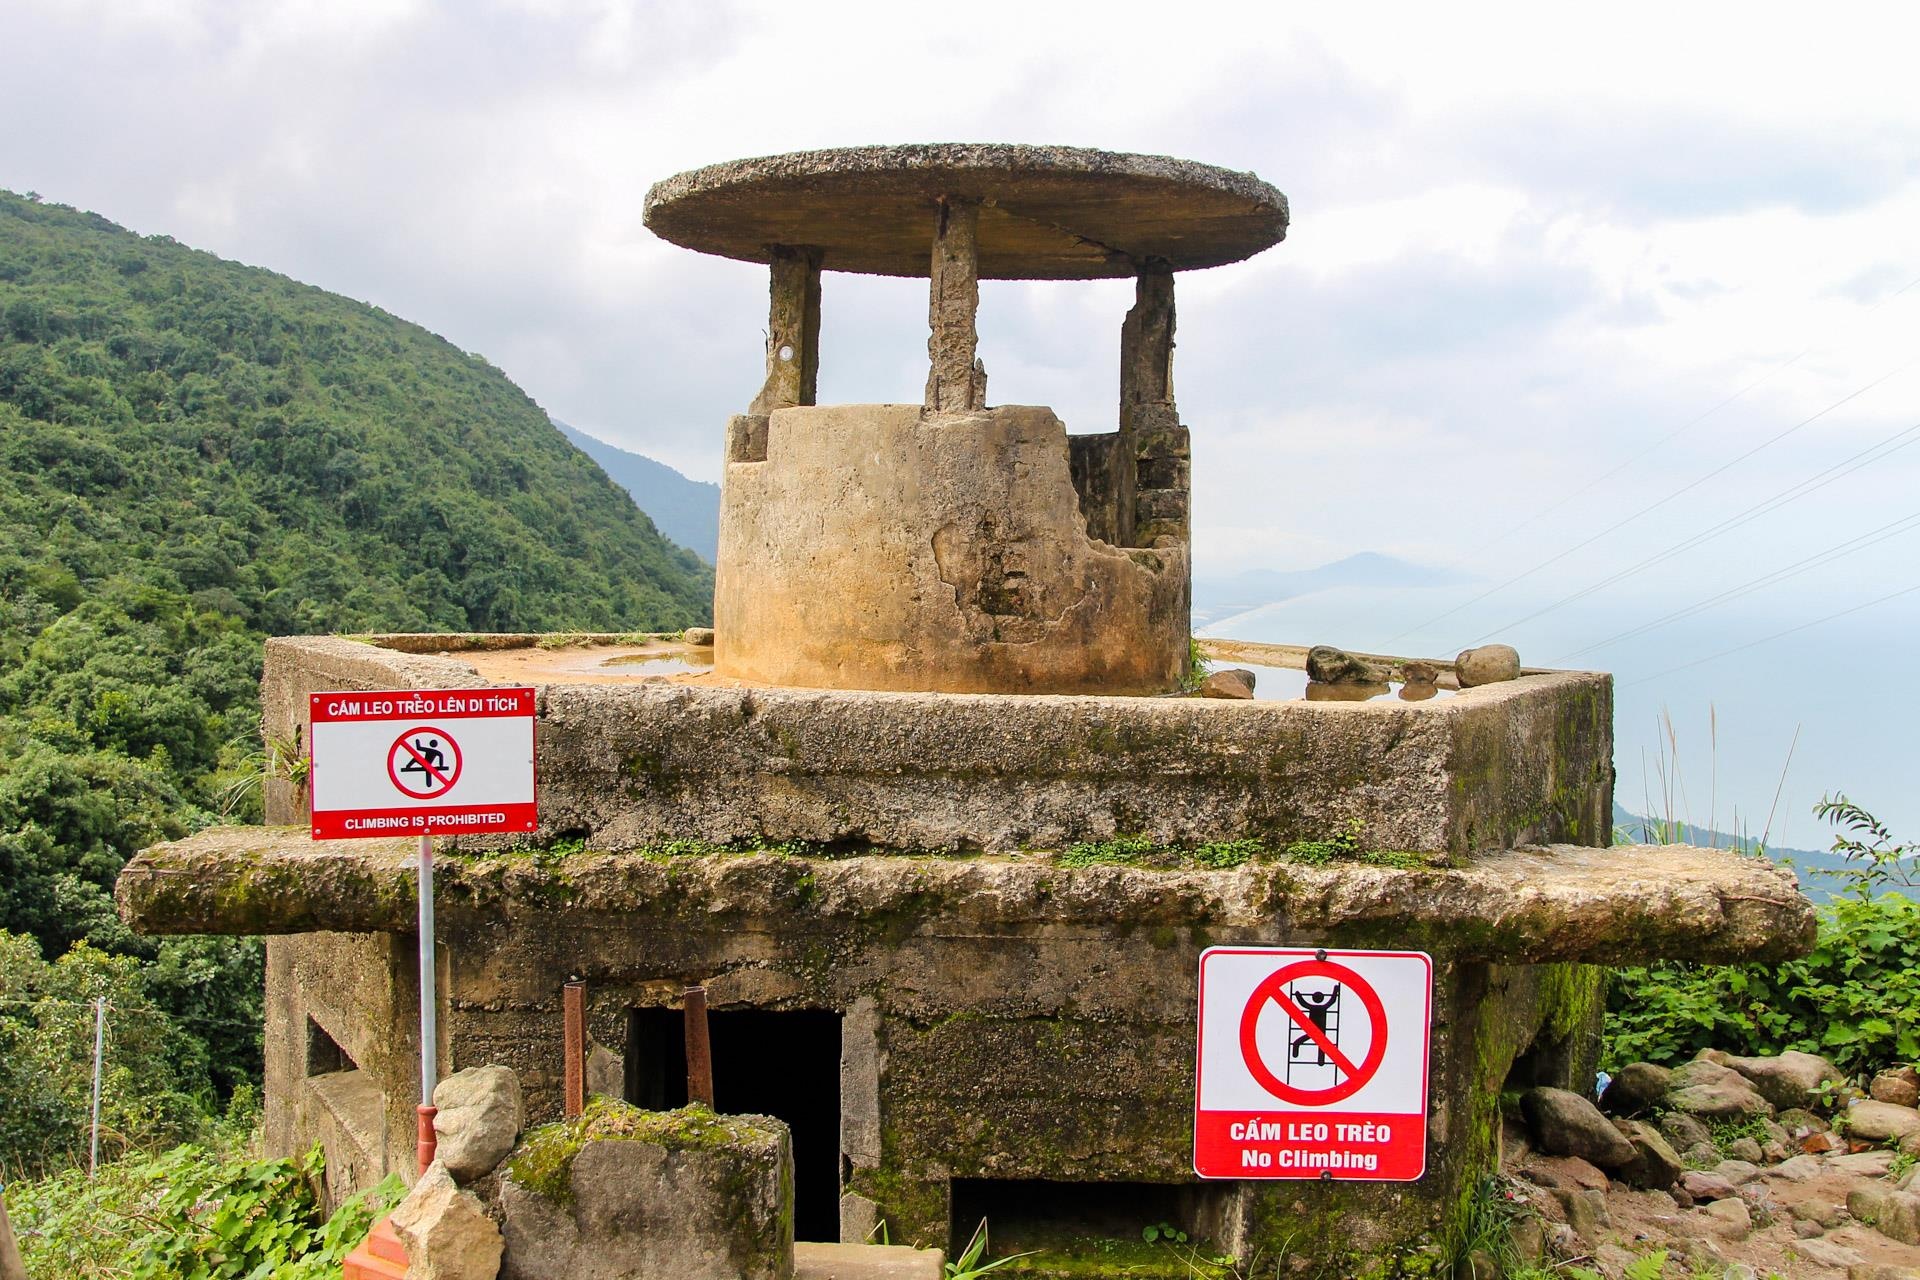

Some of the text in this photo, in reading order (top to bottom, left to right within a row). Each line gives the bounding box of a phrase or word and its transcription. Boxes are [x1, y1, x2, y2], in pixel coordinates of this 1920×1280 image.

[364, 701, 393, 715] LEO
[397, 696, 435, 714] TRÈO
[438, 697, 466, 713] LÊN
[469, 699, 484, 712] DI
[486, 695, 518, 711] TÍCH
[345, 813, 505, 830] CLIMBING IS PROHIBITED
[1230, 1116, 1391, 1143] CẤM LEO TRÈO
[1241, 1149, 1377, 1171] No Climbing
